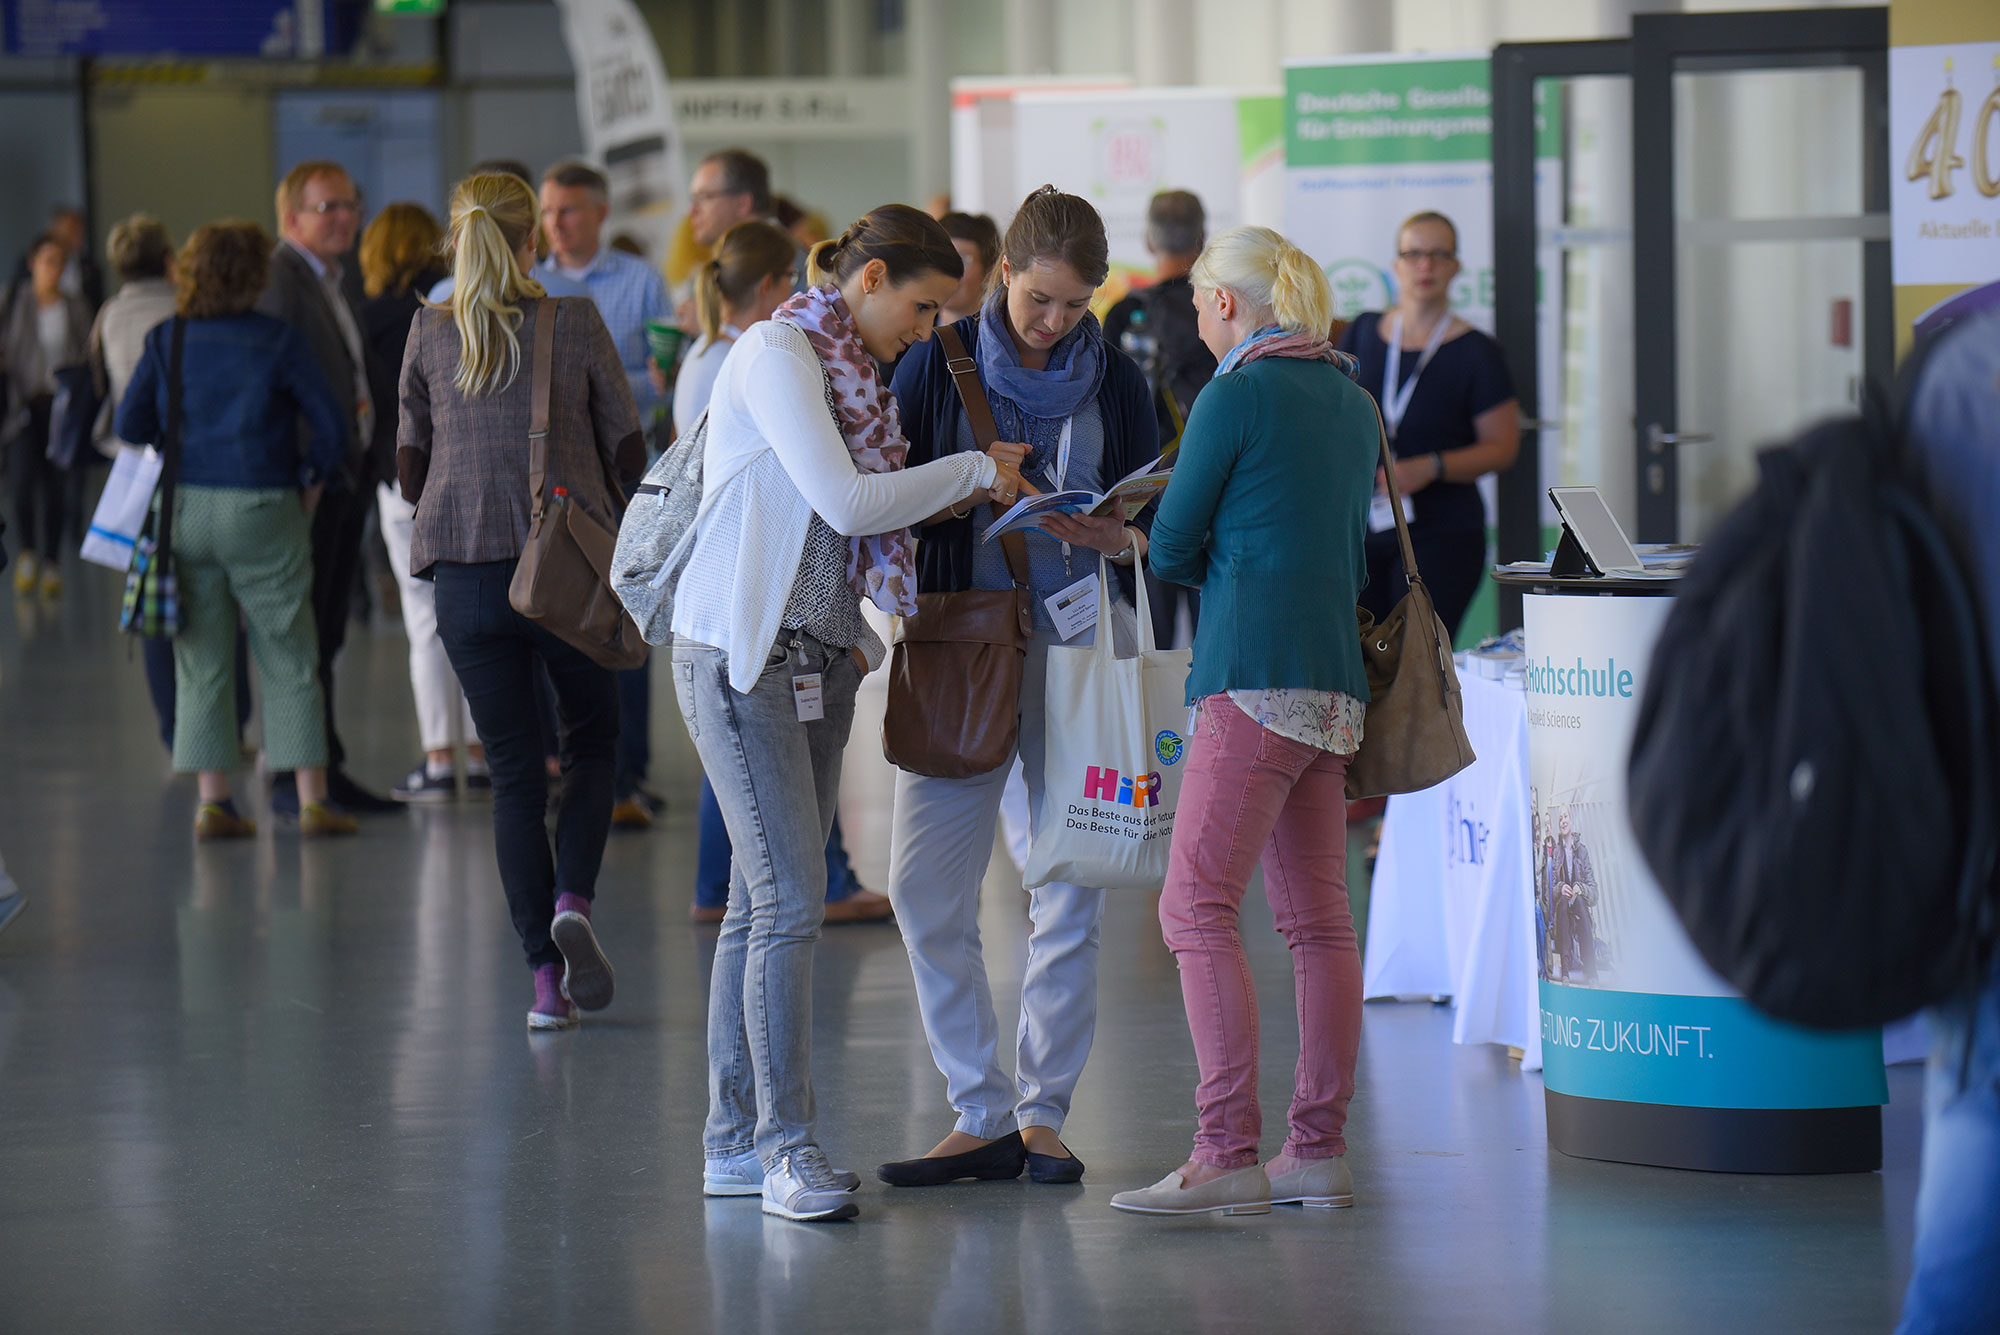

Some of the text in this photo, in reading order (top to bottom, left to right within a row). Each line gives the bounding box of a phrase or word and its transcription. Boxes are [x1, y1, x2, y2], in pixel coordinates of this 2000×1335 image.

[1297, 89, 1400, 113] Deutsche
[1298, 118, 1329, 141] für
[1919, 220, 1991, 239] Aktuelle
[1547, 710, 1581, 729] Sciences
[1160, 740, 1175, 753] BIO
[1068, 804, 1089, 816] Das
[1092, 807, 1121, 821] Beste
[1122, 815, 1142, 826] aus
[1144, 815, 1156, 826] der
[1066, 818, 1088, 830] Das
[1090, 821, 1120, 835] Beste
[1124, 827, 1139, 839] für
[1143, 830, 1157, 841] die
[1586, 1018, 1714, 1059] ZUKUNFT.
